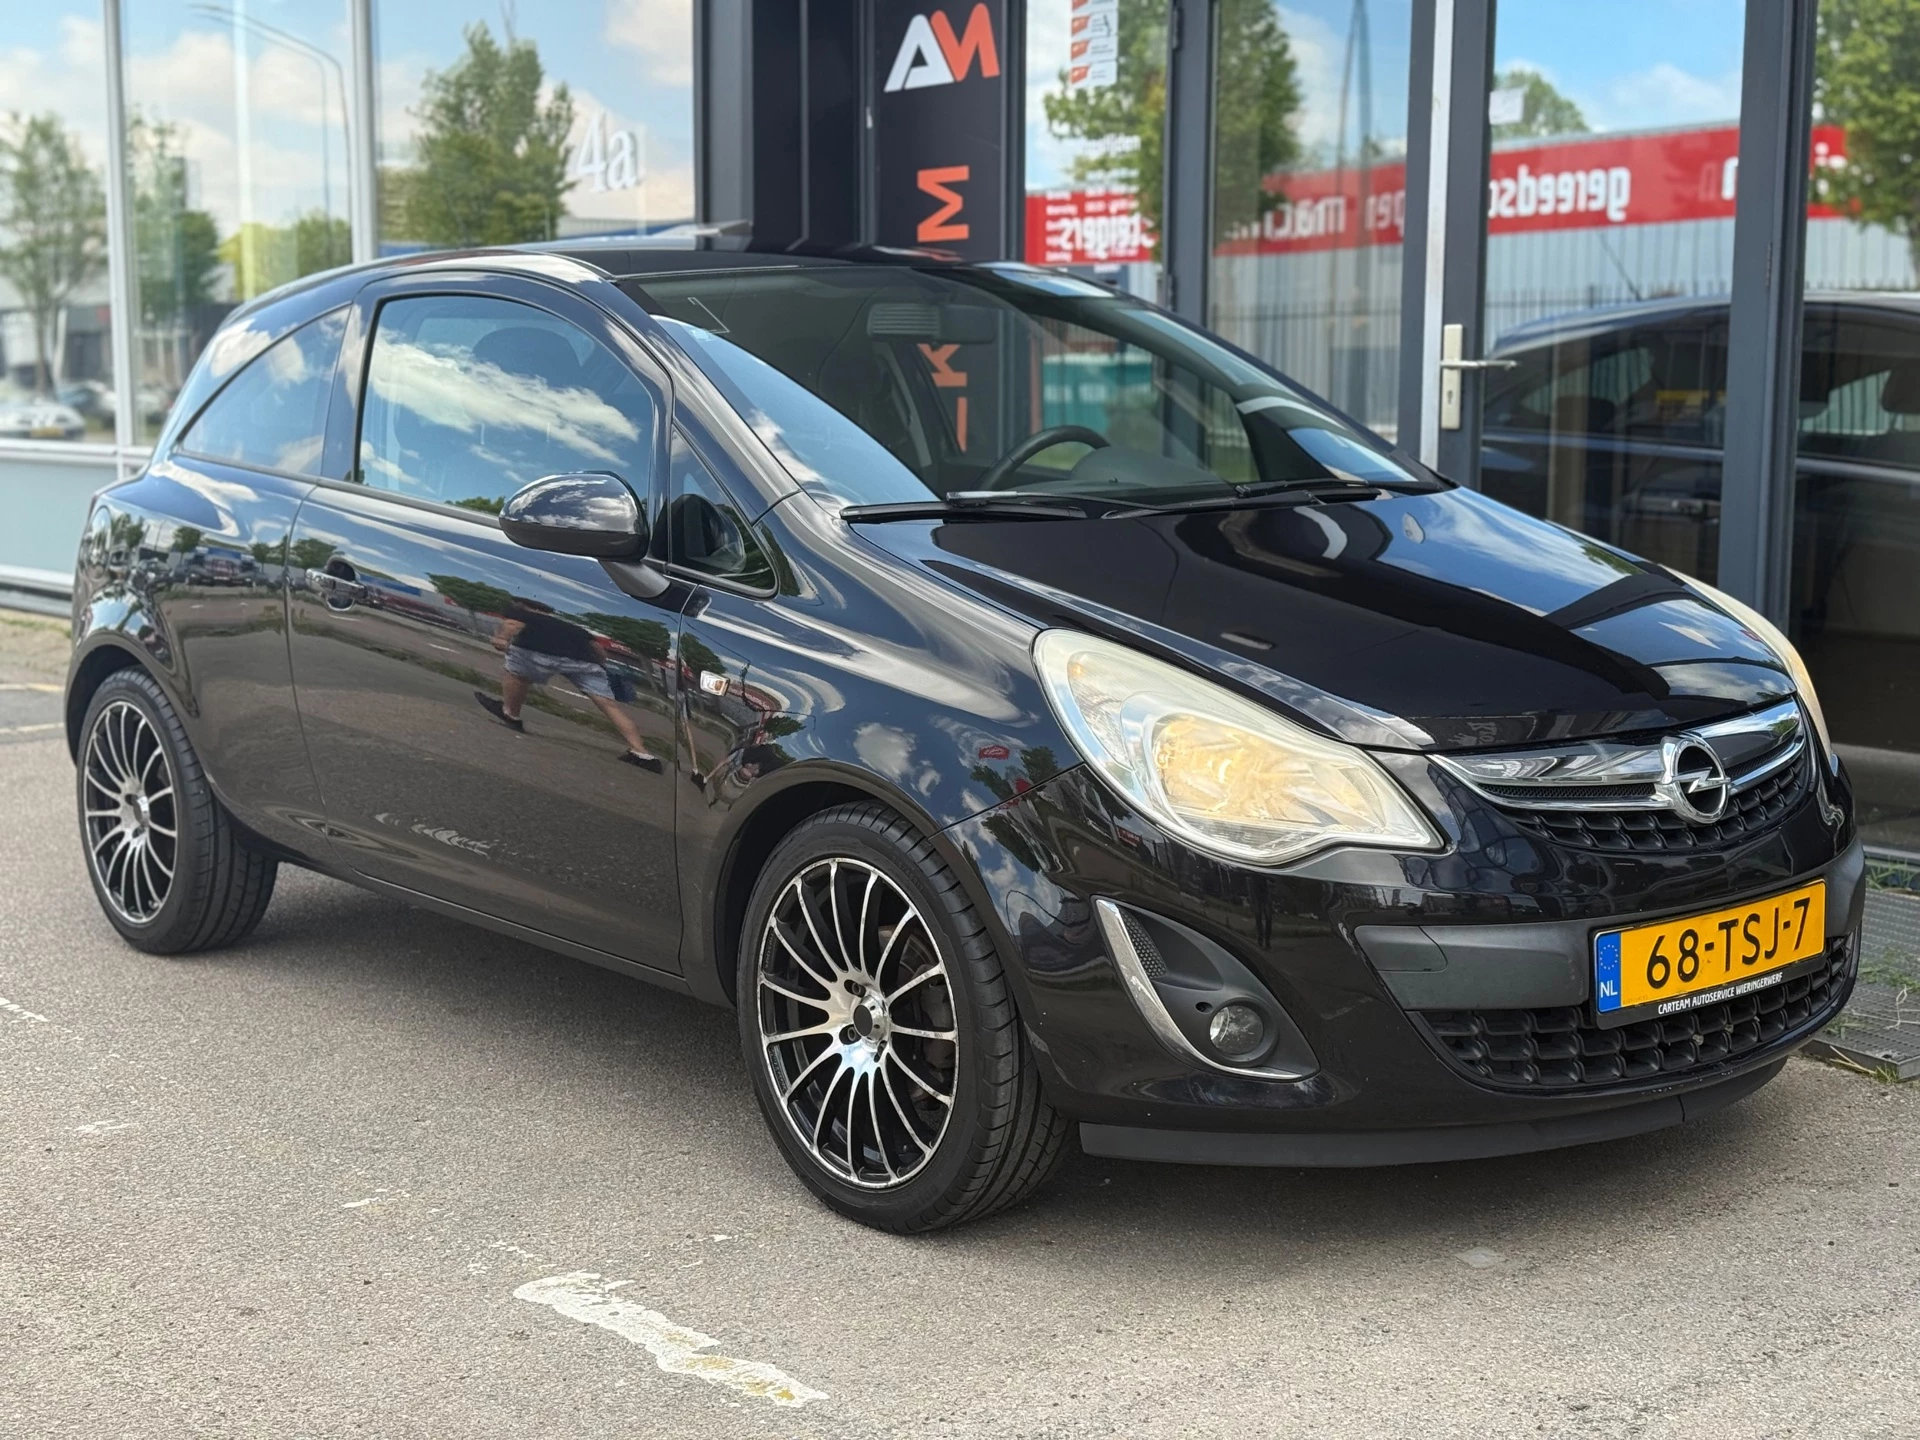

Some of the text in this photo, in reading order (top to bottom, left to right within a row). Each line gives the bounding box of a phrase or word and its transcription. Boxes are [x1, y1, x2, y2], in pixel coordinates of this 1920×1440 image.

[884, 3, 1000, 92] AM
[577, 111, 637, 191] 4a
[1646, 897, 1811, 989] 68-TSJ-7
[1600, 980, 1618, 998] NL
[1658, 973, 1783, 1015] CARTEAM AUTOSERVICE WIERINGERWERF
